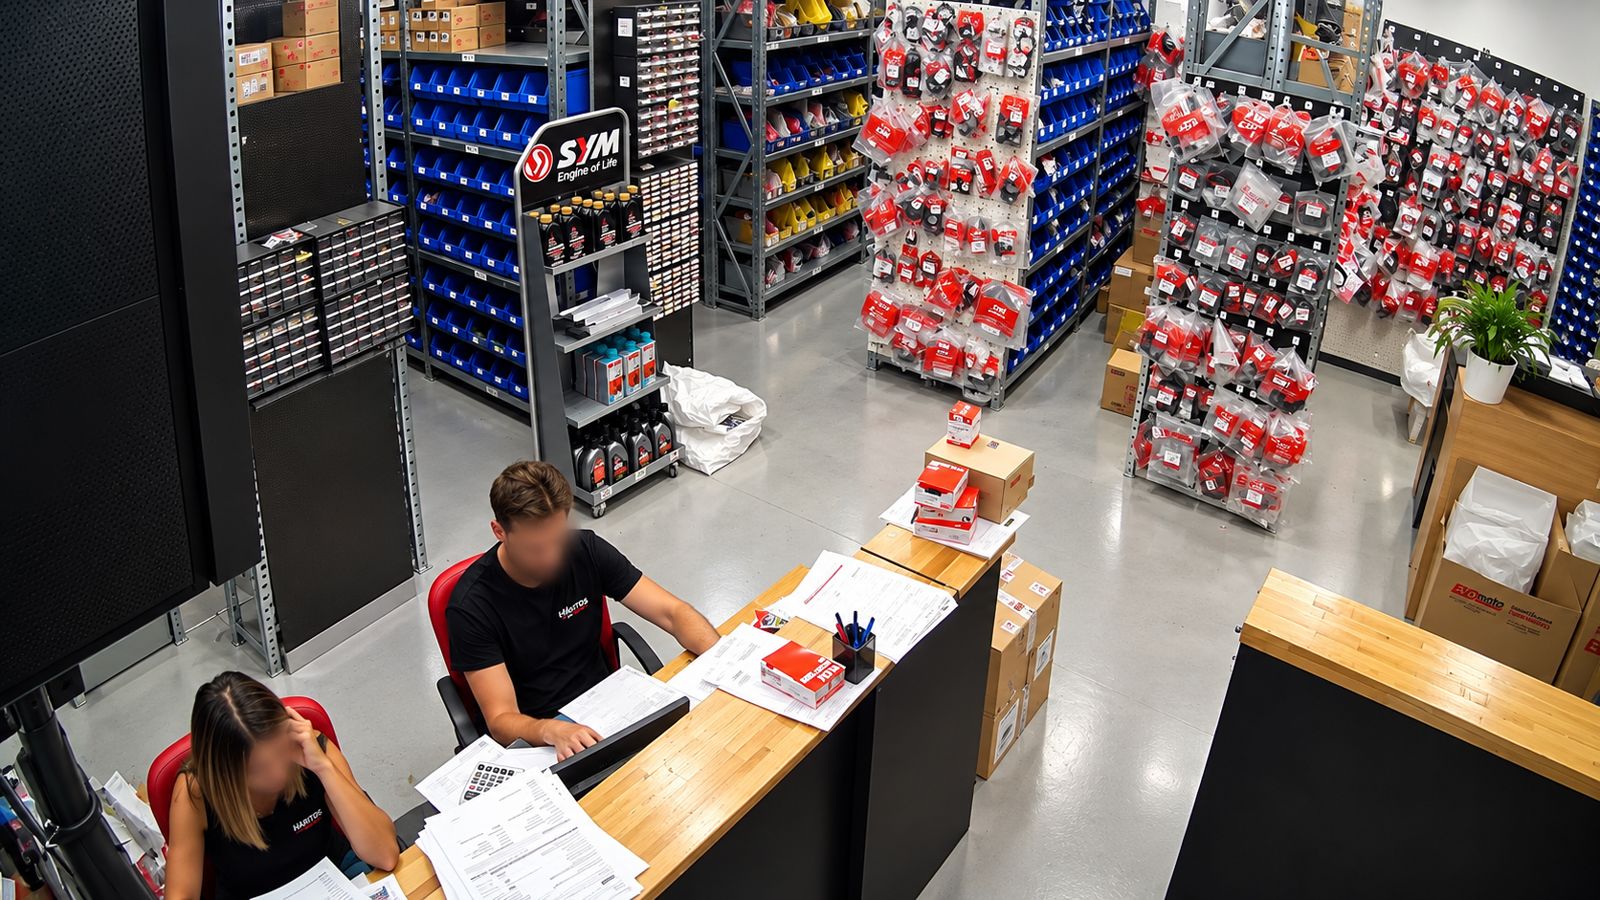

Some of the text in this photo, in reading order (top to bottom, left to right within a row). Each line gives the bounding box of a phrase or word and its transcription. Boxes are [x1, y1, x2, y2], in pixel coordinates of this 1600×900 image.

[557, 128, 620, 169] SYM
[557, 157, 618, 182] Engine of Life
